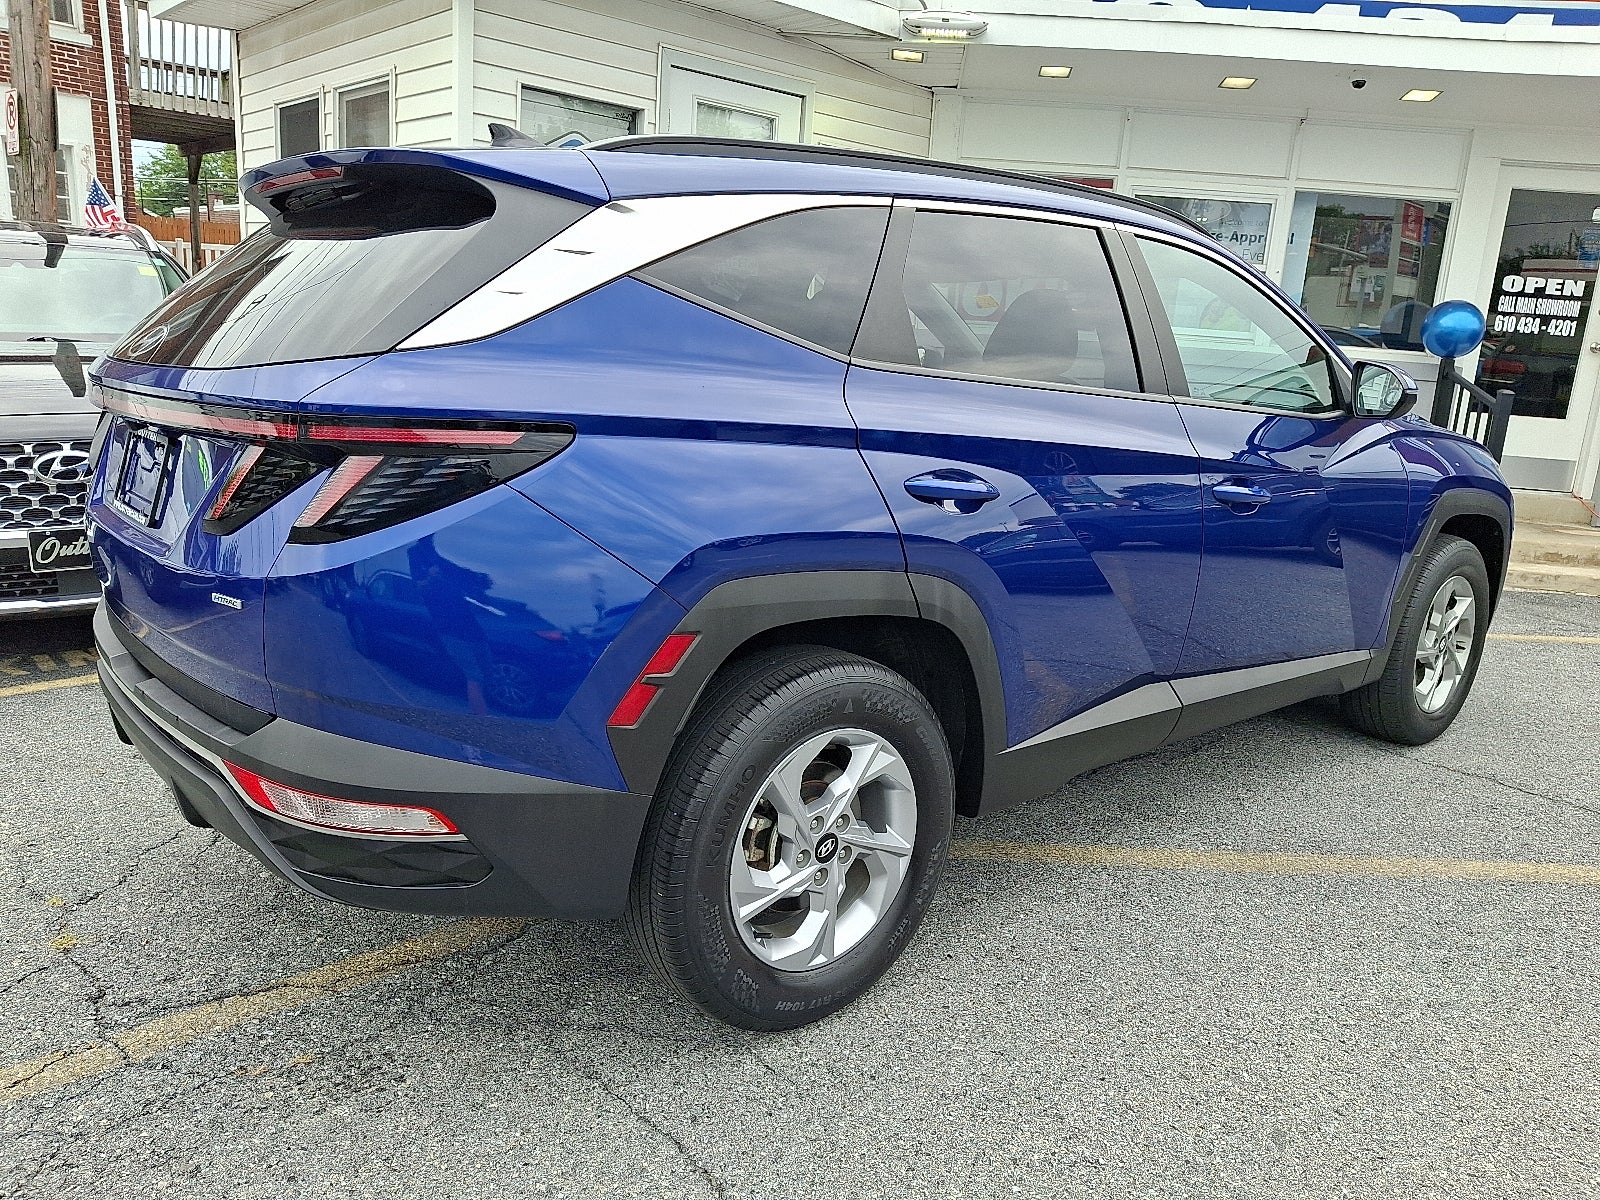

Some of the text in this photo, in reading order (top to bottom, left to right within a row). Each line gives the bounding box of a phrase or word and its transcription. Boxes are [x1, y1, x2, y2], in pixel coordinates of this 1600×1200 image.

[1242, 248, 1265, 262] Eve
[1502, 275, 1585, 297] OPEN
[1498, 295, 1581, 318] CALL MAIN SHOWROOM
[1494, 315, 1516, 333] 610
[1517, 316, 1540, 335] 434
[1547, 319, 1577, 337] 4201
[213, 593, 240, 607] HTRAC
[705, 764, 757, 868] KUMHO
[775, 999, 806, 1012] 104H
